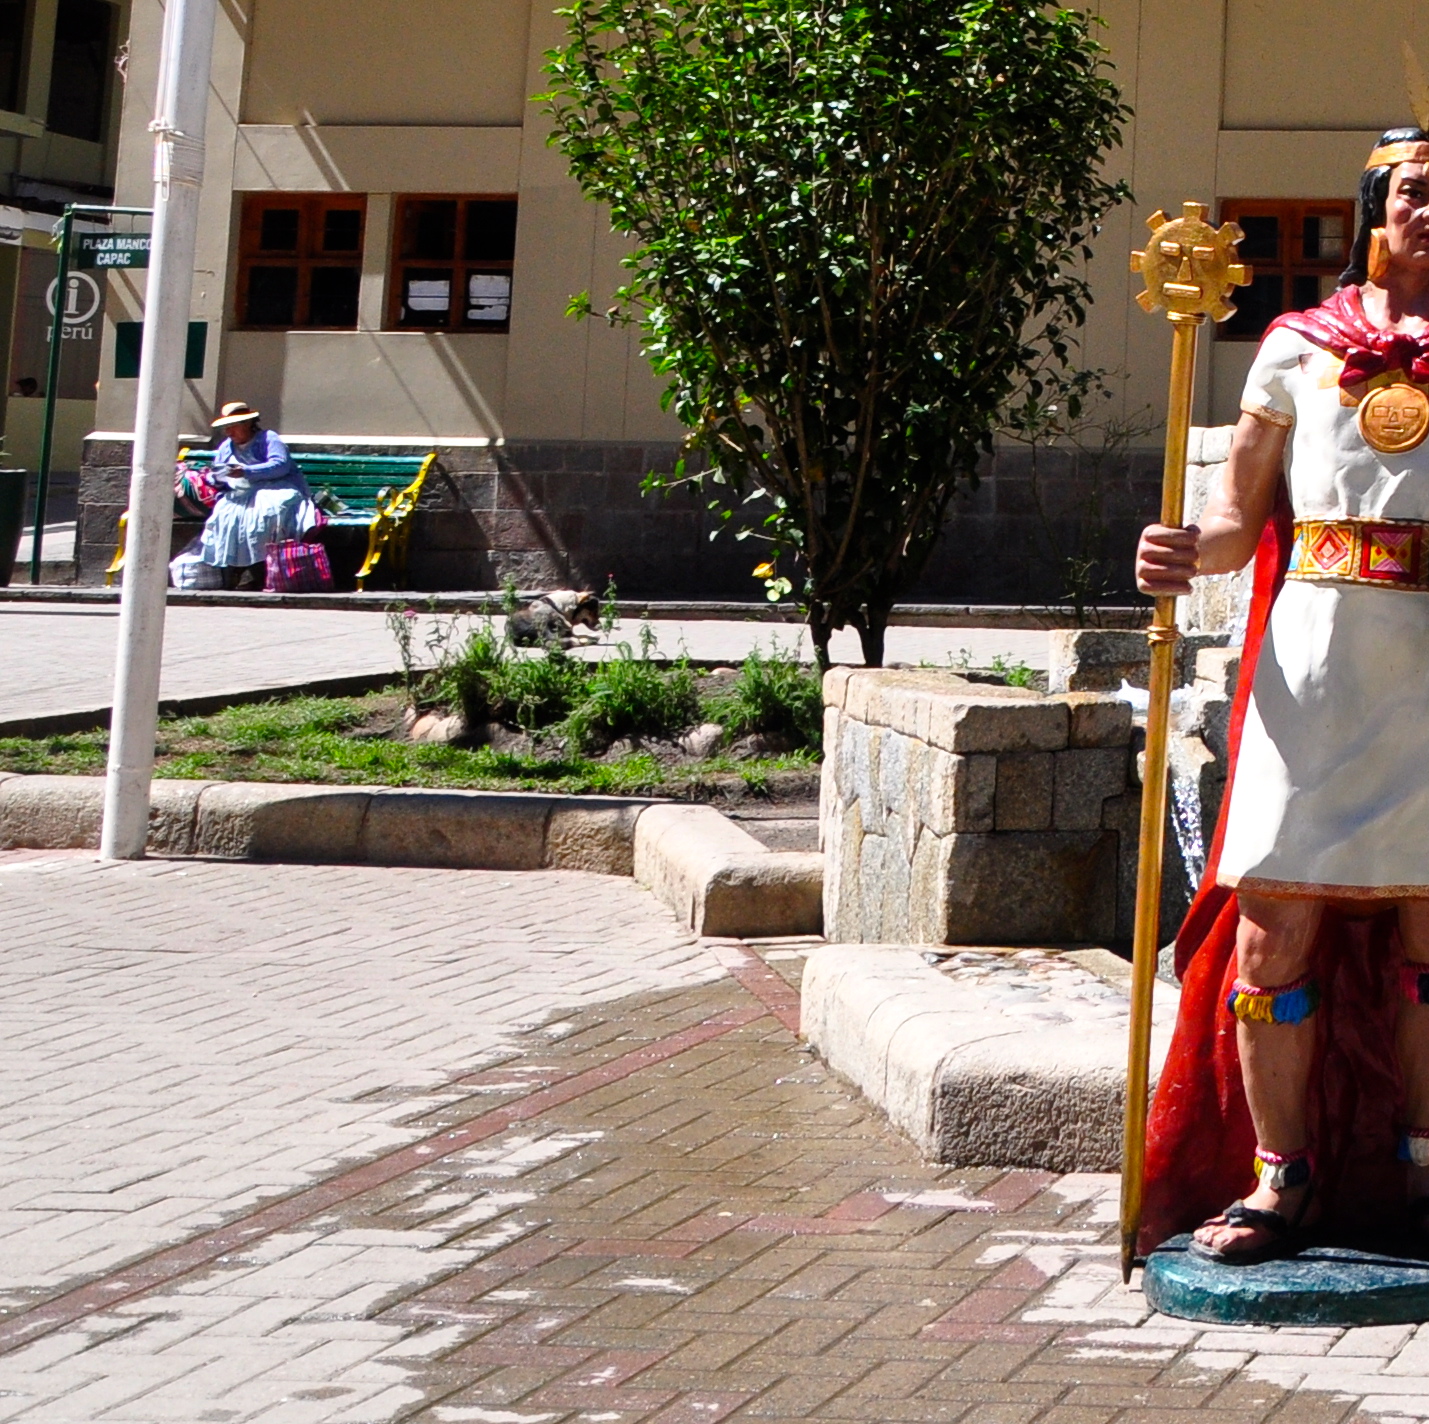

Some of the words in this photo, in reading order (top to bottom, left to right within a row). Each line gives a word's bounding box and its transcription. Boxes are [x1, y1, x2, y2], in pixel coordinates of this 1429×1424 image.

[83, 238, 114, 250] PLAZA
[116, 238, 152, 250] MANCO
[96, 252, 131, 265] CAPAC
